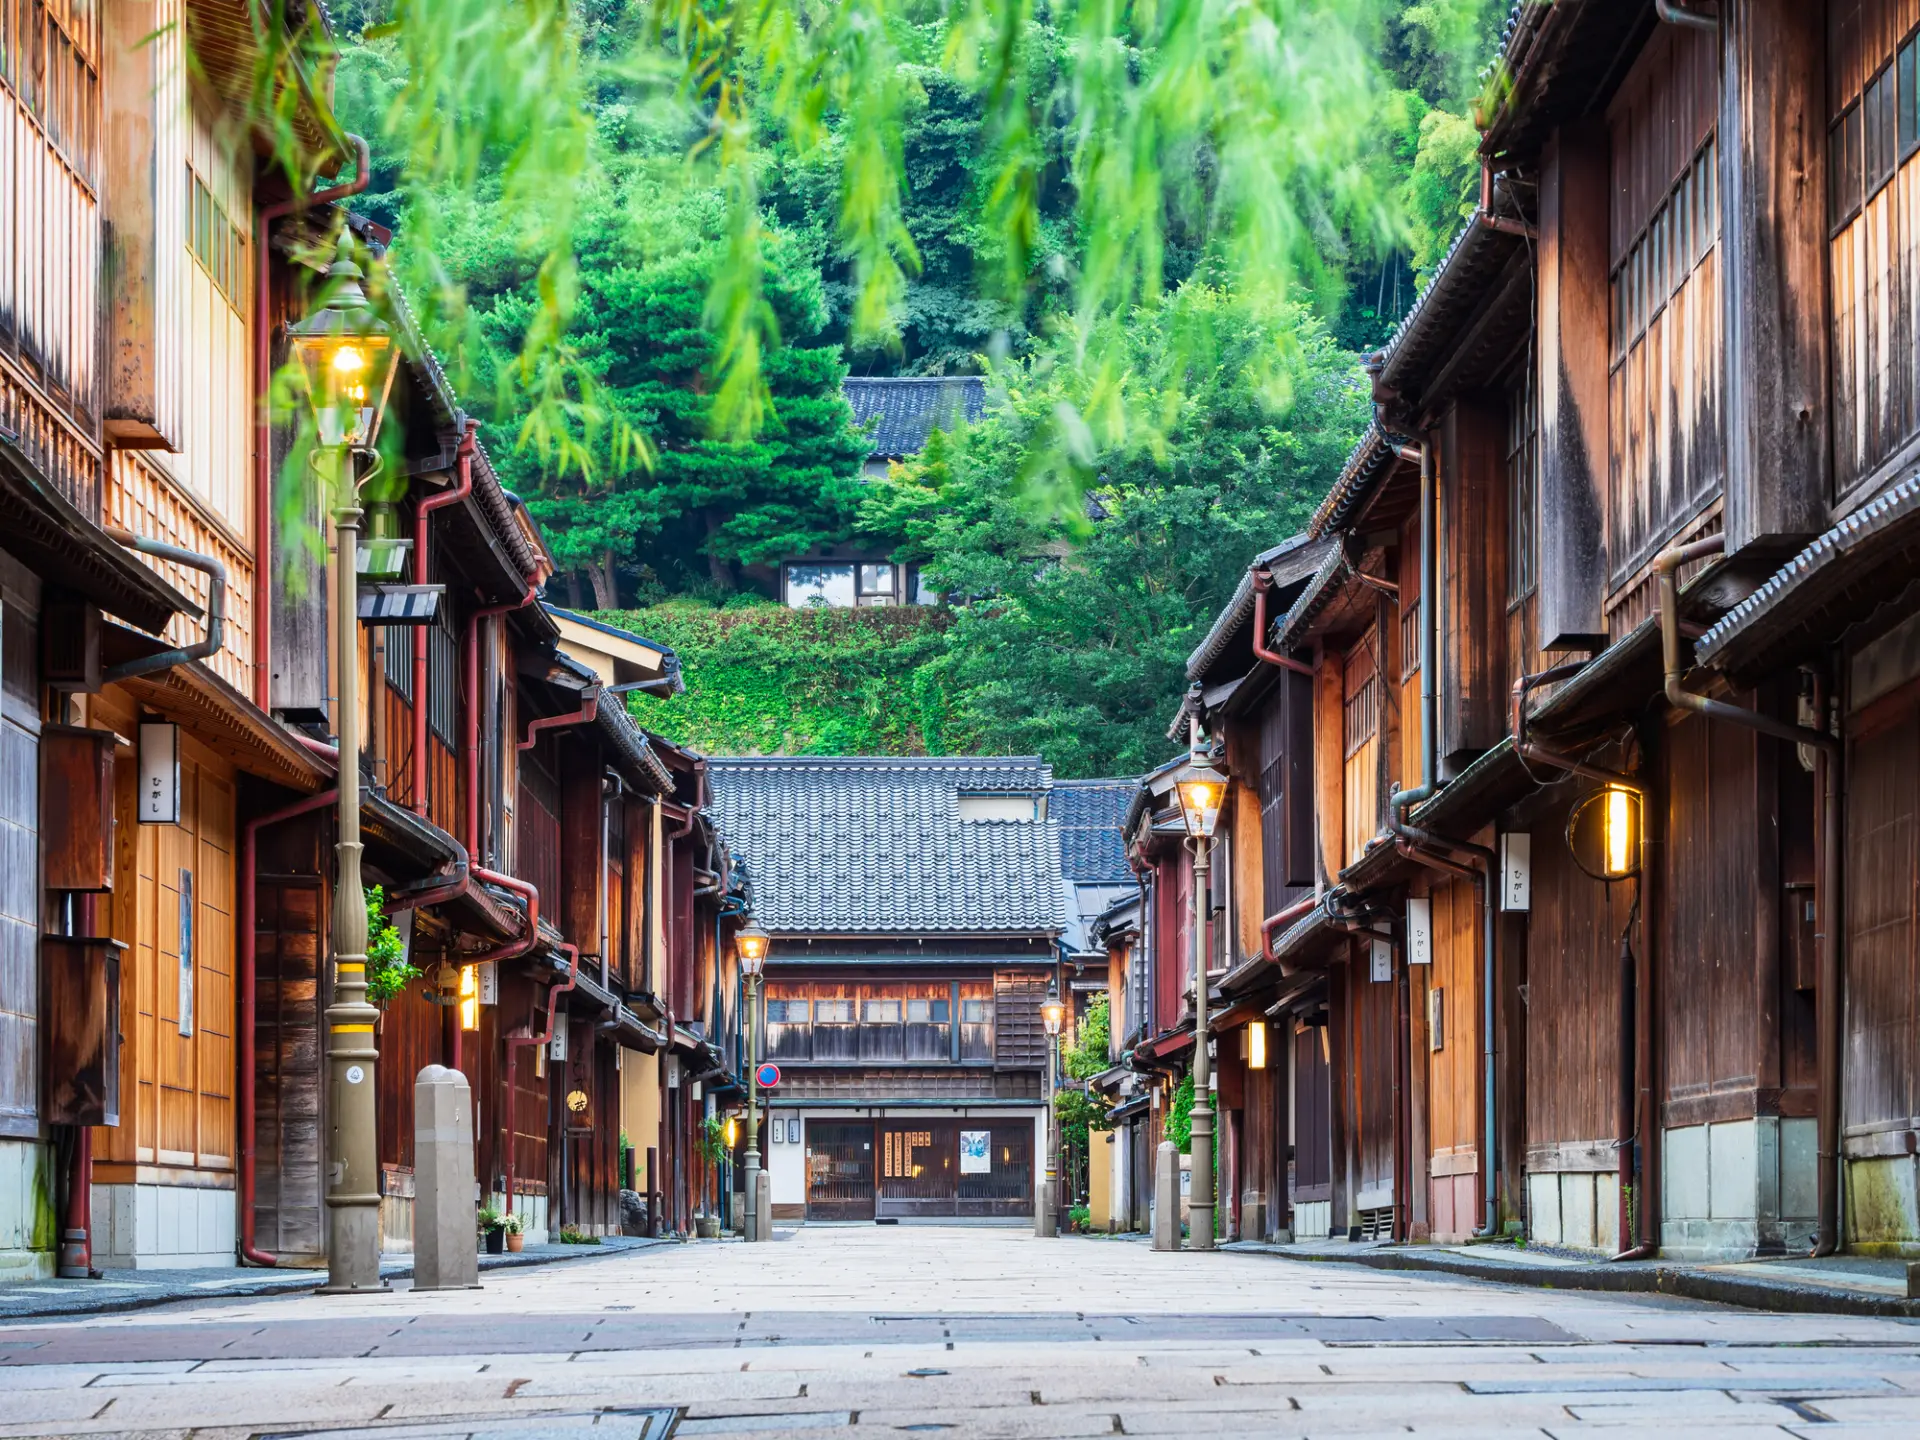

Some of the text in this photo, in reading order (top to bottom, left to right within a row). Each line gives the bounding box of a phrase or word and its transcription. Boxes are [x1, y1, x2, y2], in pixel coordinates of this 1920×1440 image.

[152, 777, 162, 813] ひがし
[1512, 869, 1523, 904] ひがし
[1416, 929, 1424, 958] ひがし
